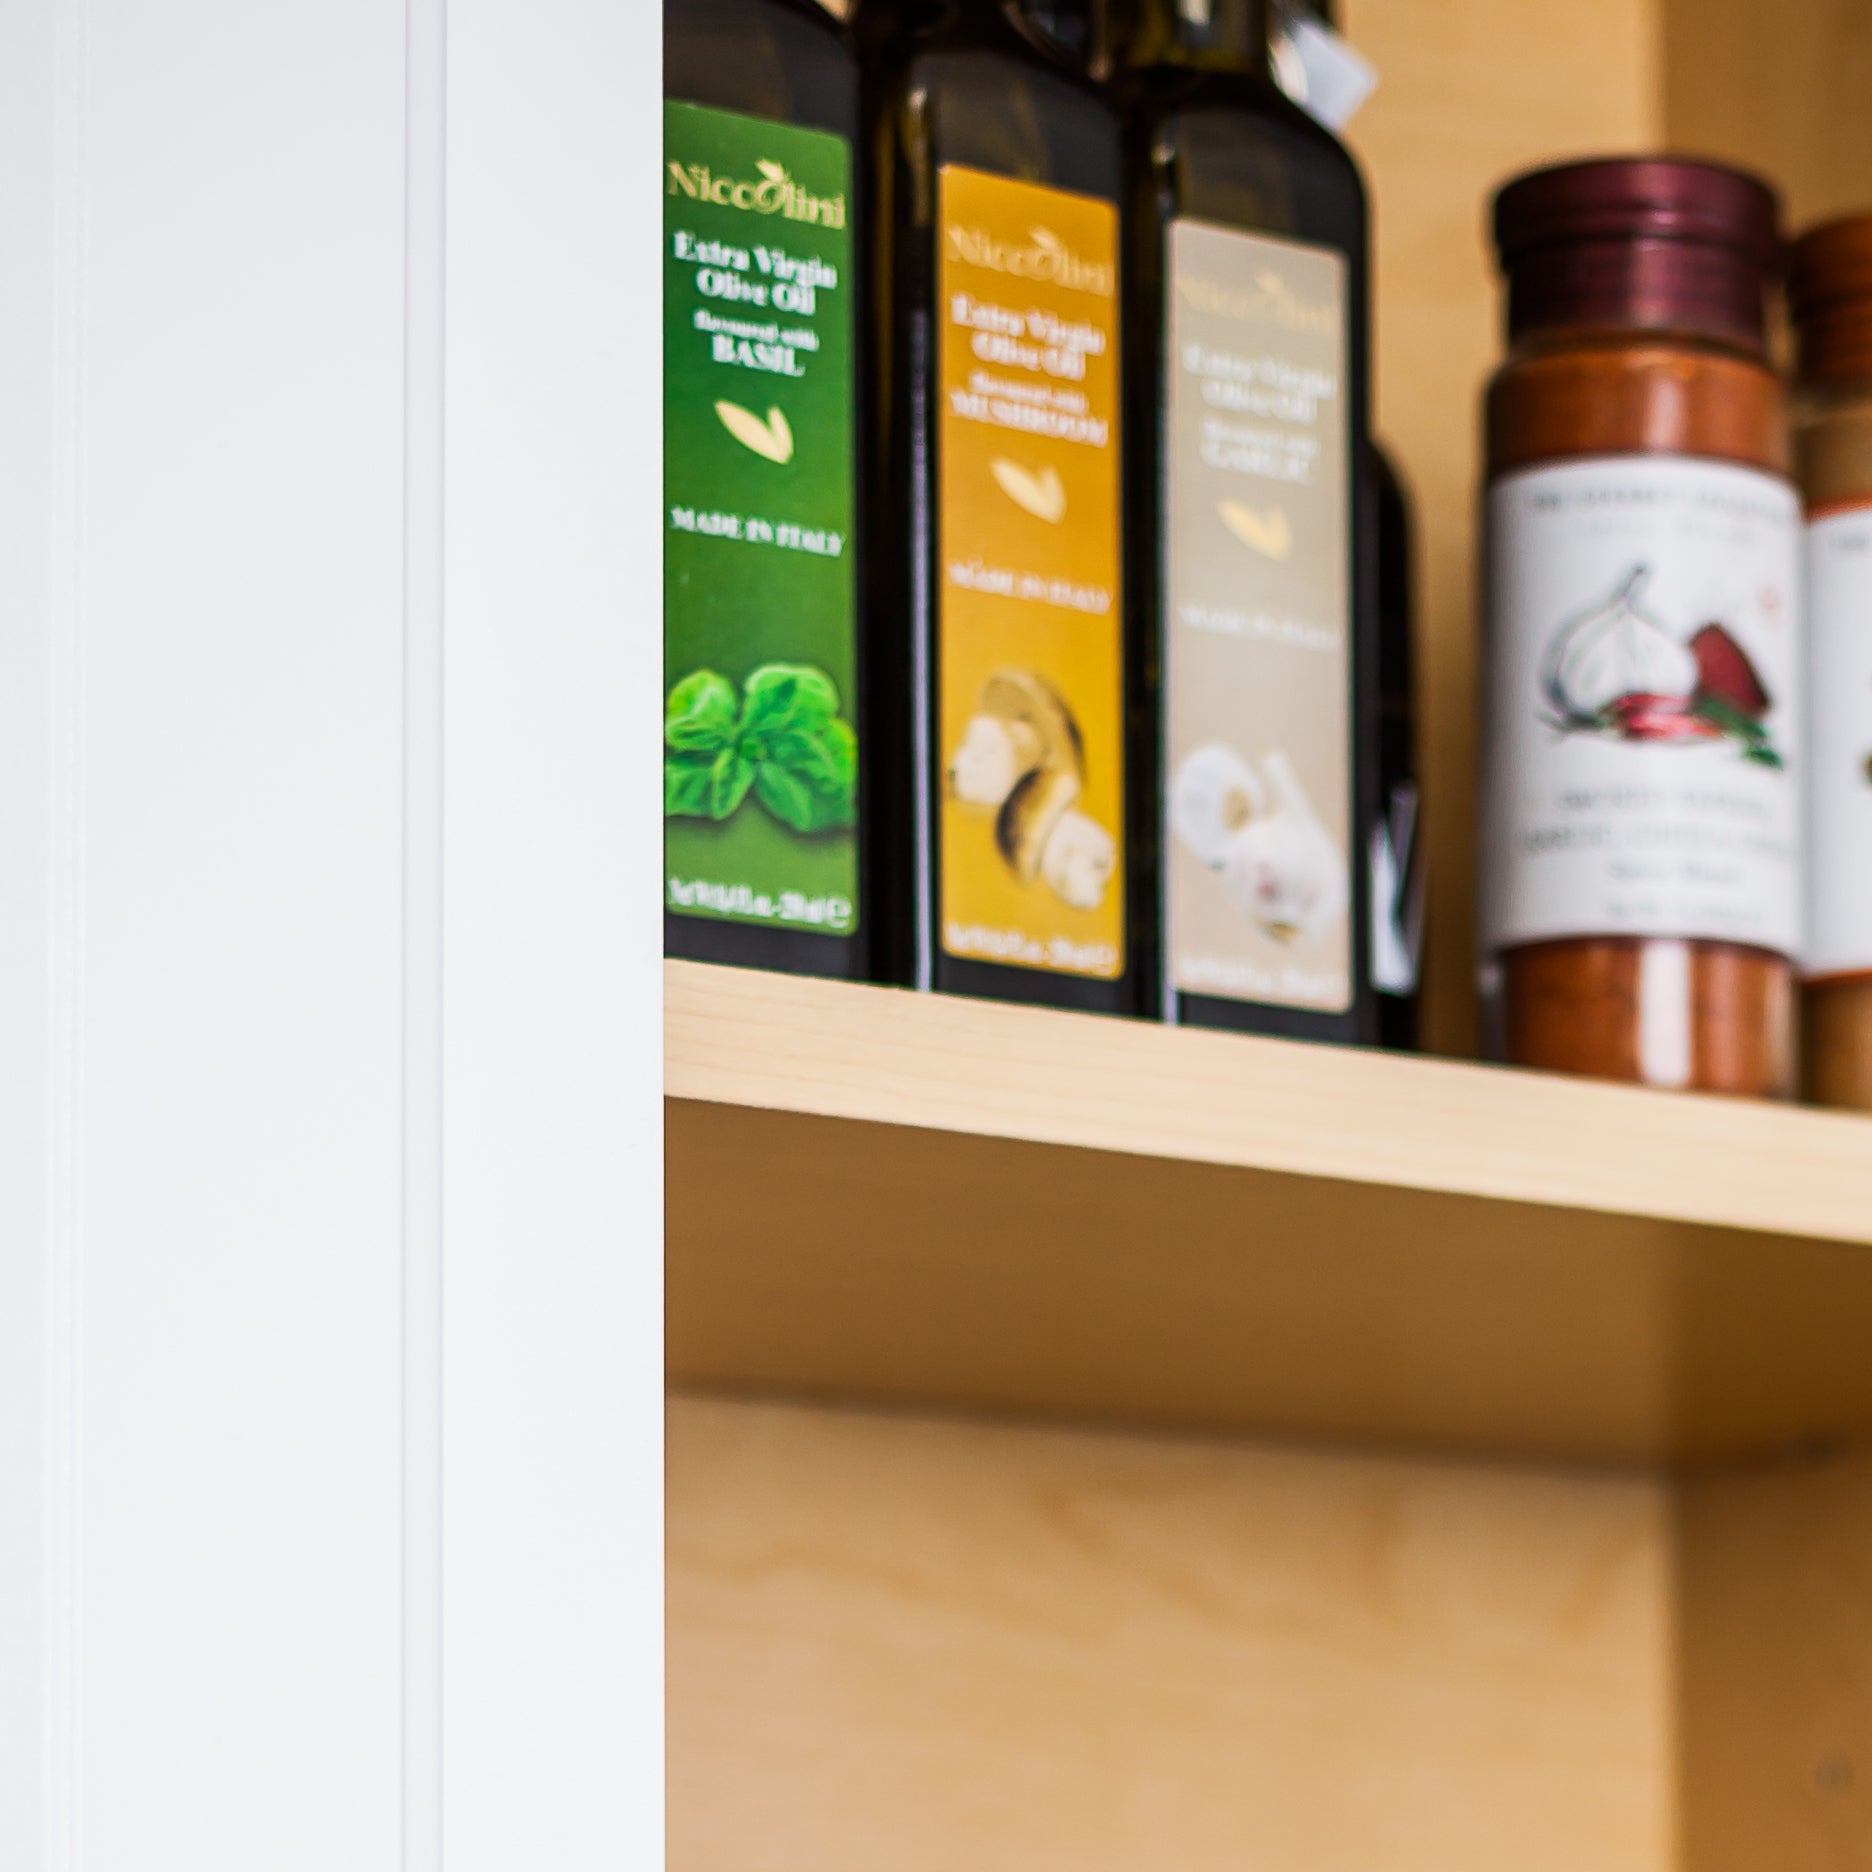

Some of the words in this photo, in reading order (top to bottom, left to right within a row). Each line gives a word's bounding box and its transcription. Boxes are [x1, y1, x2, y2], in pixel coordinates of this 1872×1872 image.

[673, 230, 750, 271] Extra
[752, 246, 838, 290] Virgin
[697, 268, 768, 307] Olive
[772, 282, 815, 316] Oil
[712, 334, 806, 377] BASIL
[671, 506, 742, 540] MADE
[776, 524, 845, 557] ITALY
